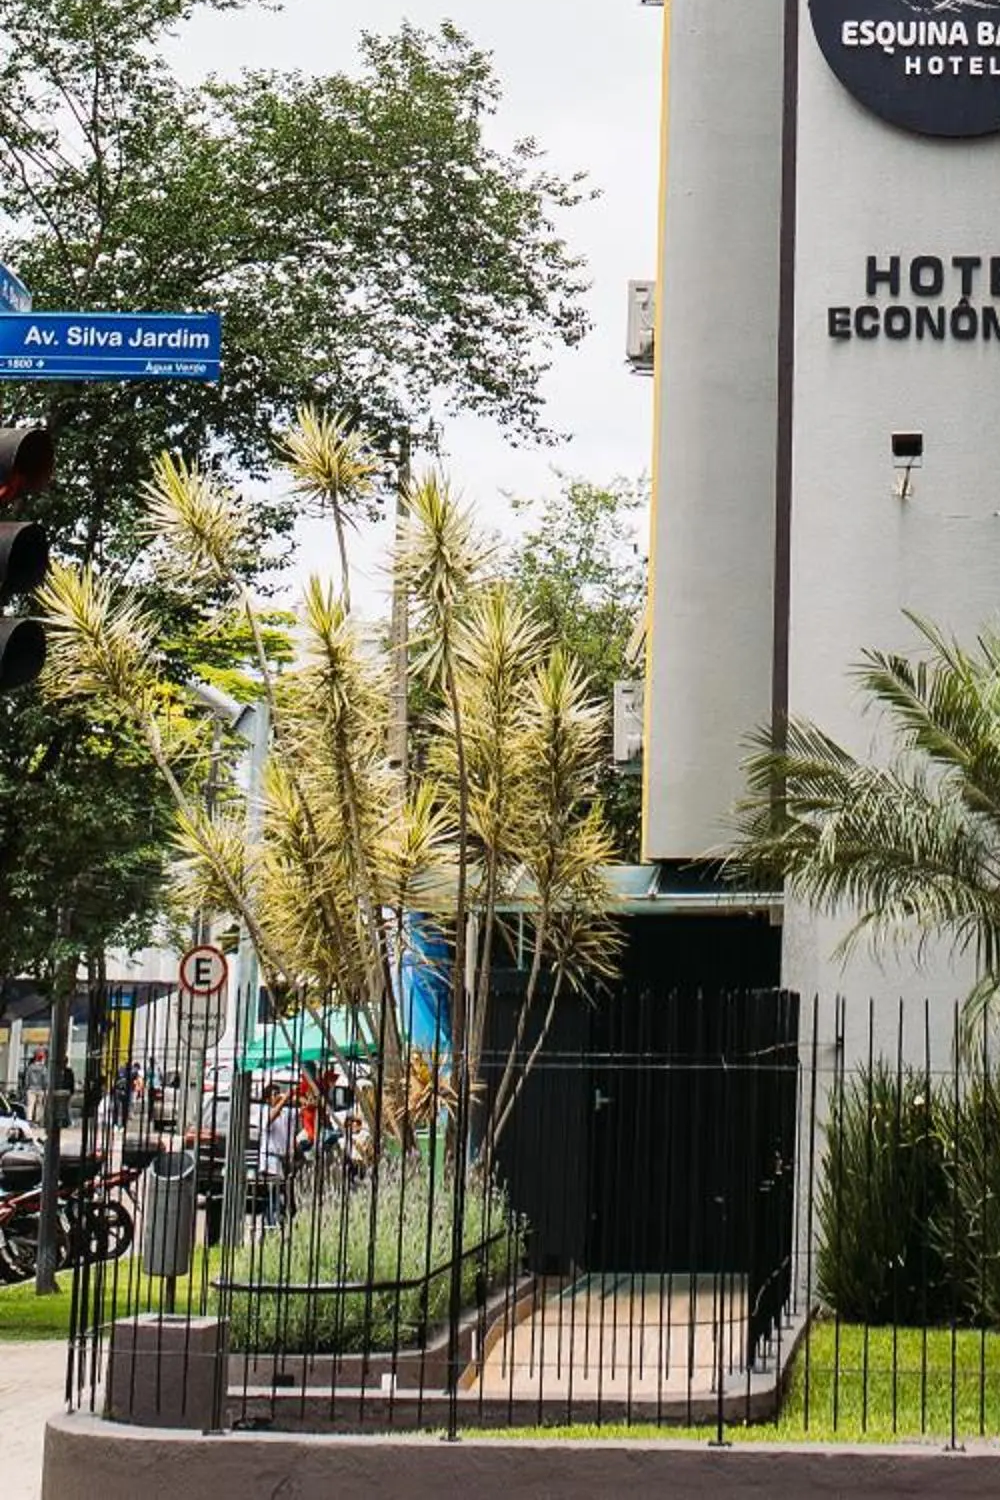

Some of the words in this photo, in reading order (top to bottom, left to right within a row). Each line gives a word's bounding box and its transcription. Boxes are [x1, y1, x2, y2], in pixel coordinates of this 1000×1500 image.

[841, 20, 969, 54] ESQUINA
[24, 325, 59, 346] Av.
[67, 326, 123, 347] Silva
[128, 328, 210, 349] Jardim
[195, 957, 212, 984] E
